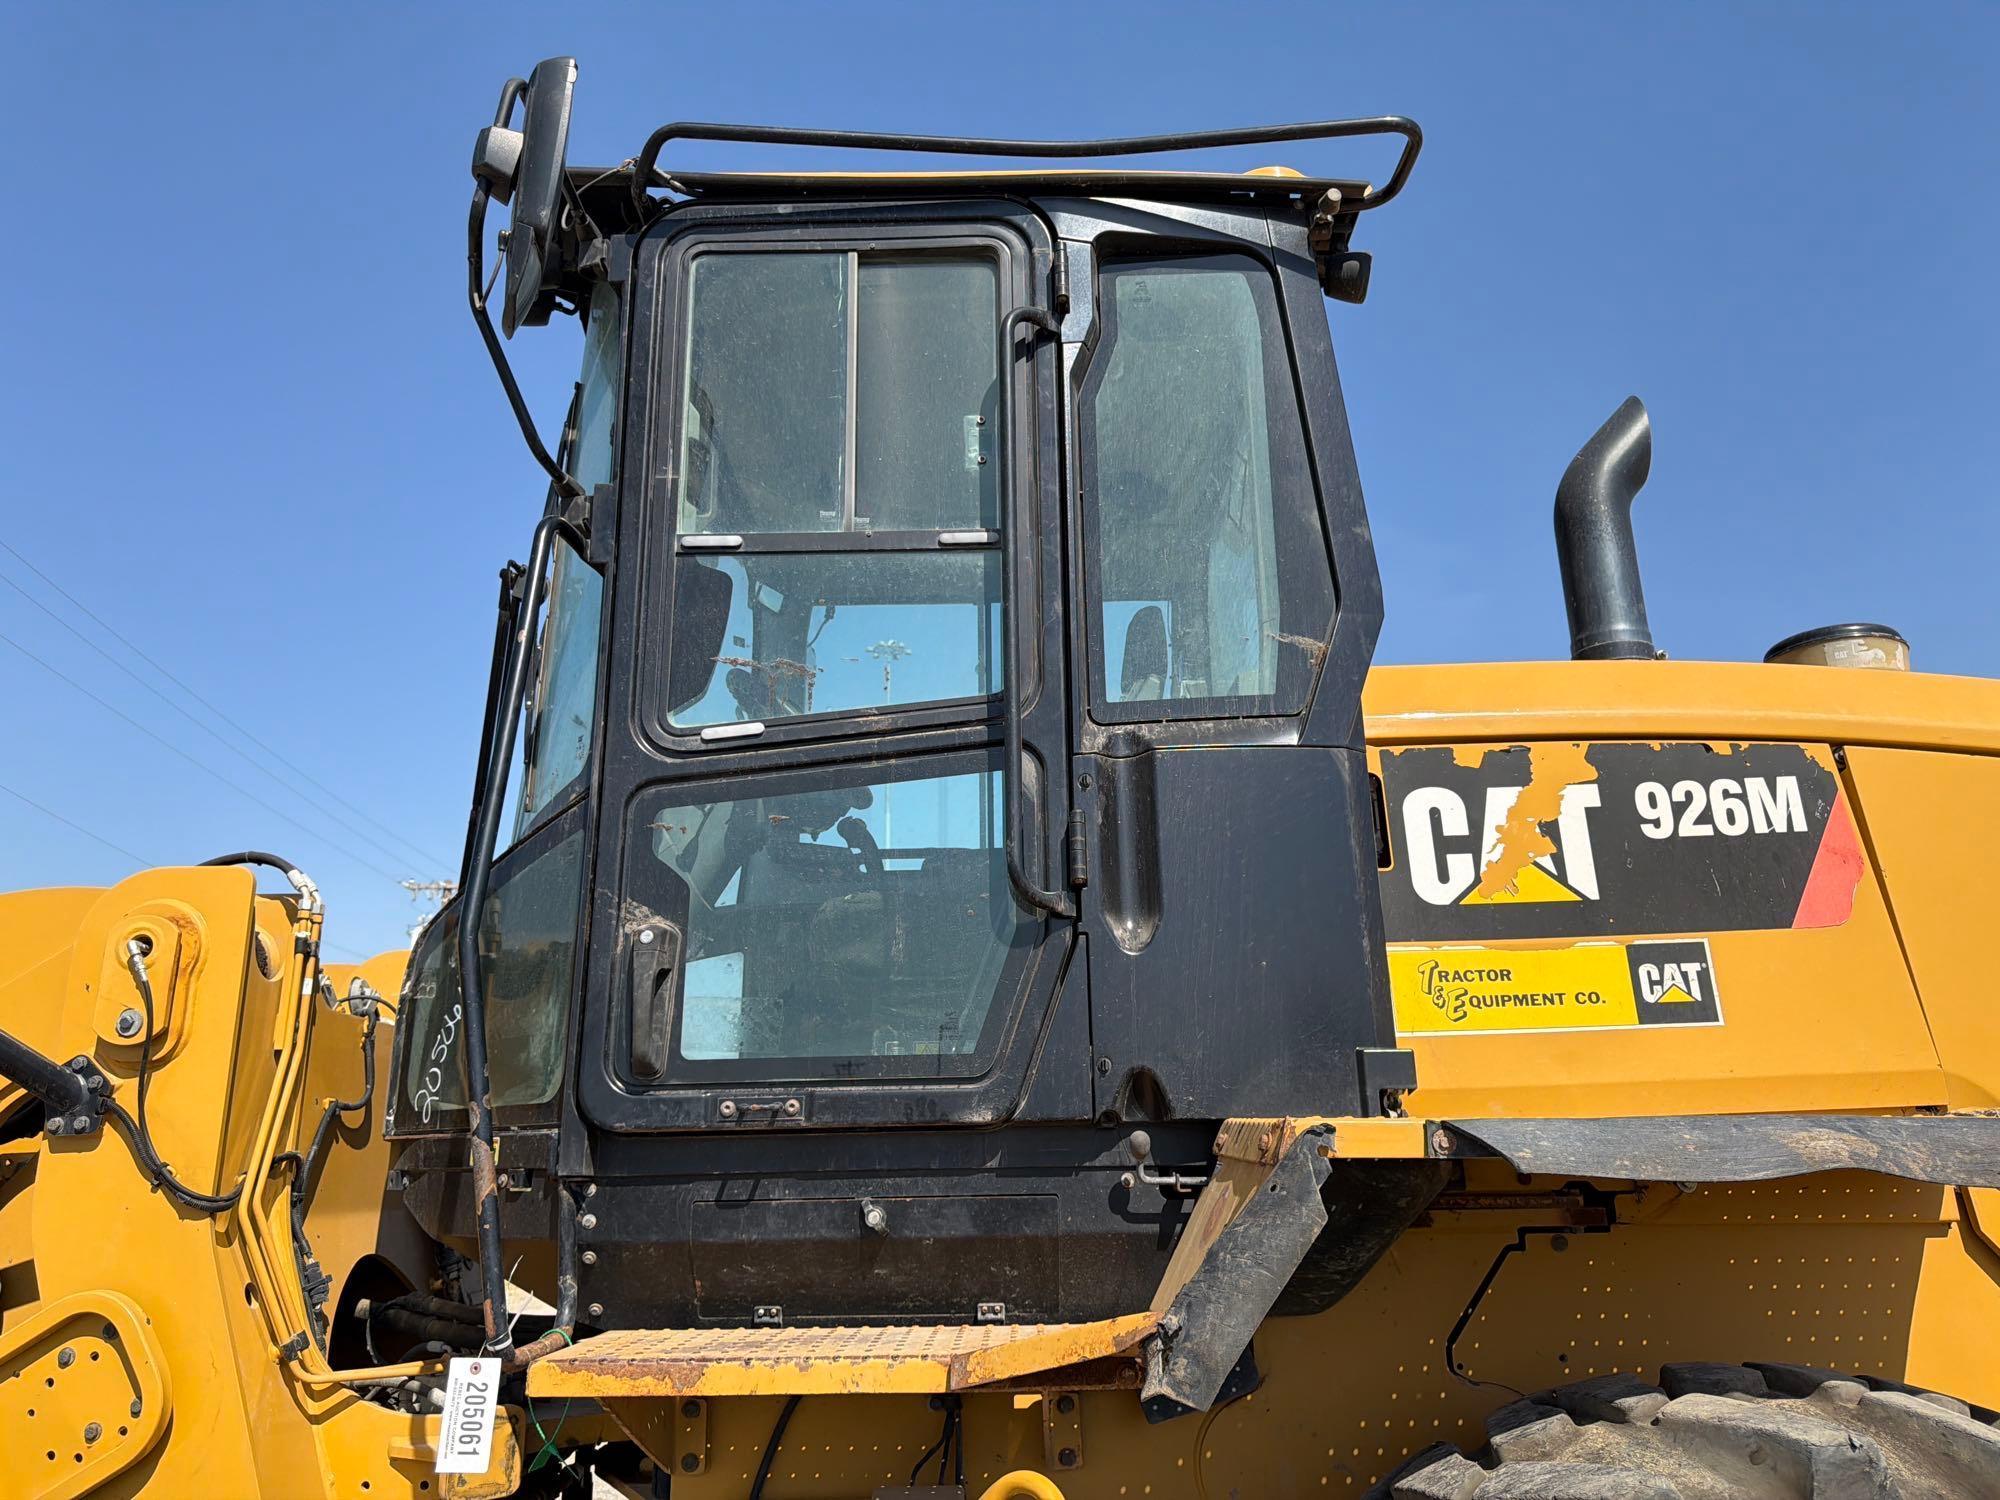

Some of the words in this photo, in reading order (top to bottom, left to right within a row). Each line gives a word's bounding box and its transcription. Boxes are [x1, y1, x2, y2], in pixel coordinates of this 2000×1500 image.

[1402, 783, 1602, 906] CAT
[1635, 776, 1808, 840] 926M
[1418, 959, 1512, 995] TRACTOR
[1446, 987, 1566, 1022] EQUIPMENT
[1574, 991, 1607, 1005] CO.
[1638, 962, 1703, 1004] CAT
[414, 987, 462, 1124] 20506
[459, 1382, 488, 1455] 205061
